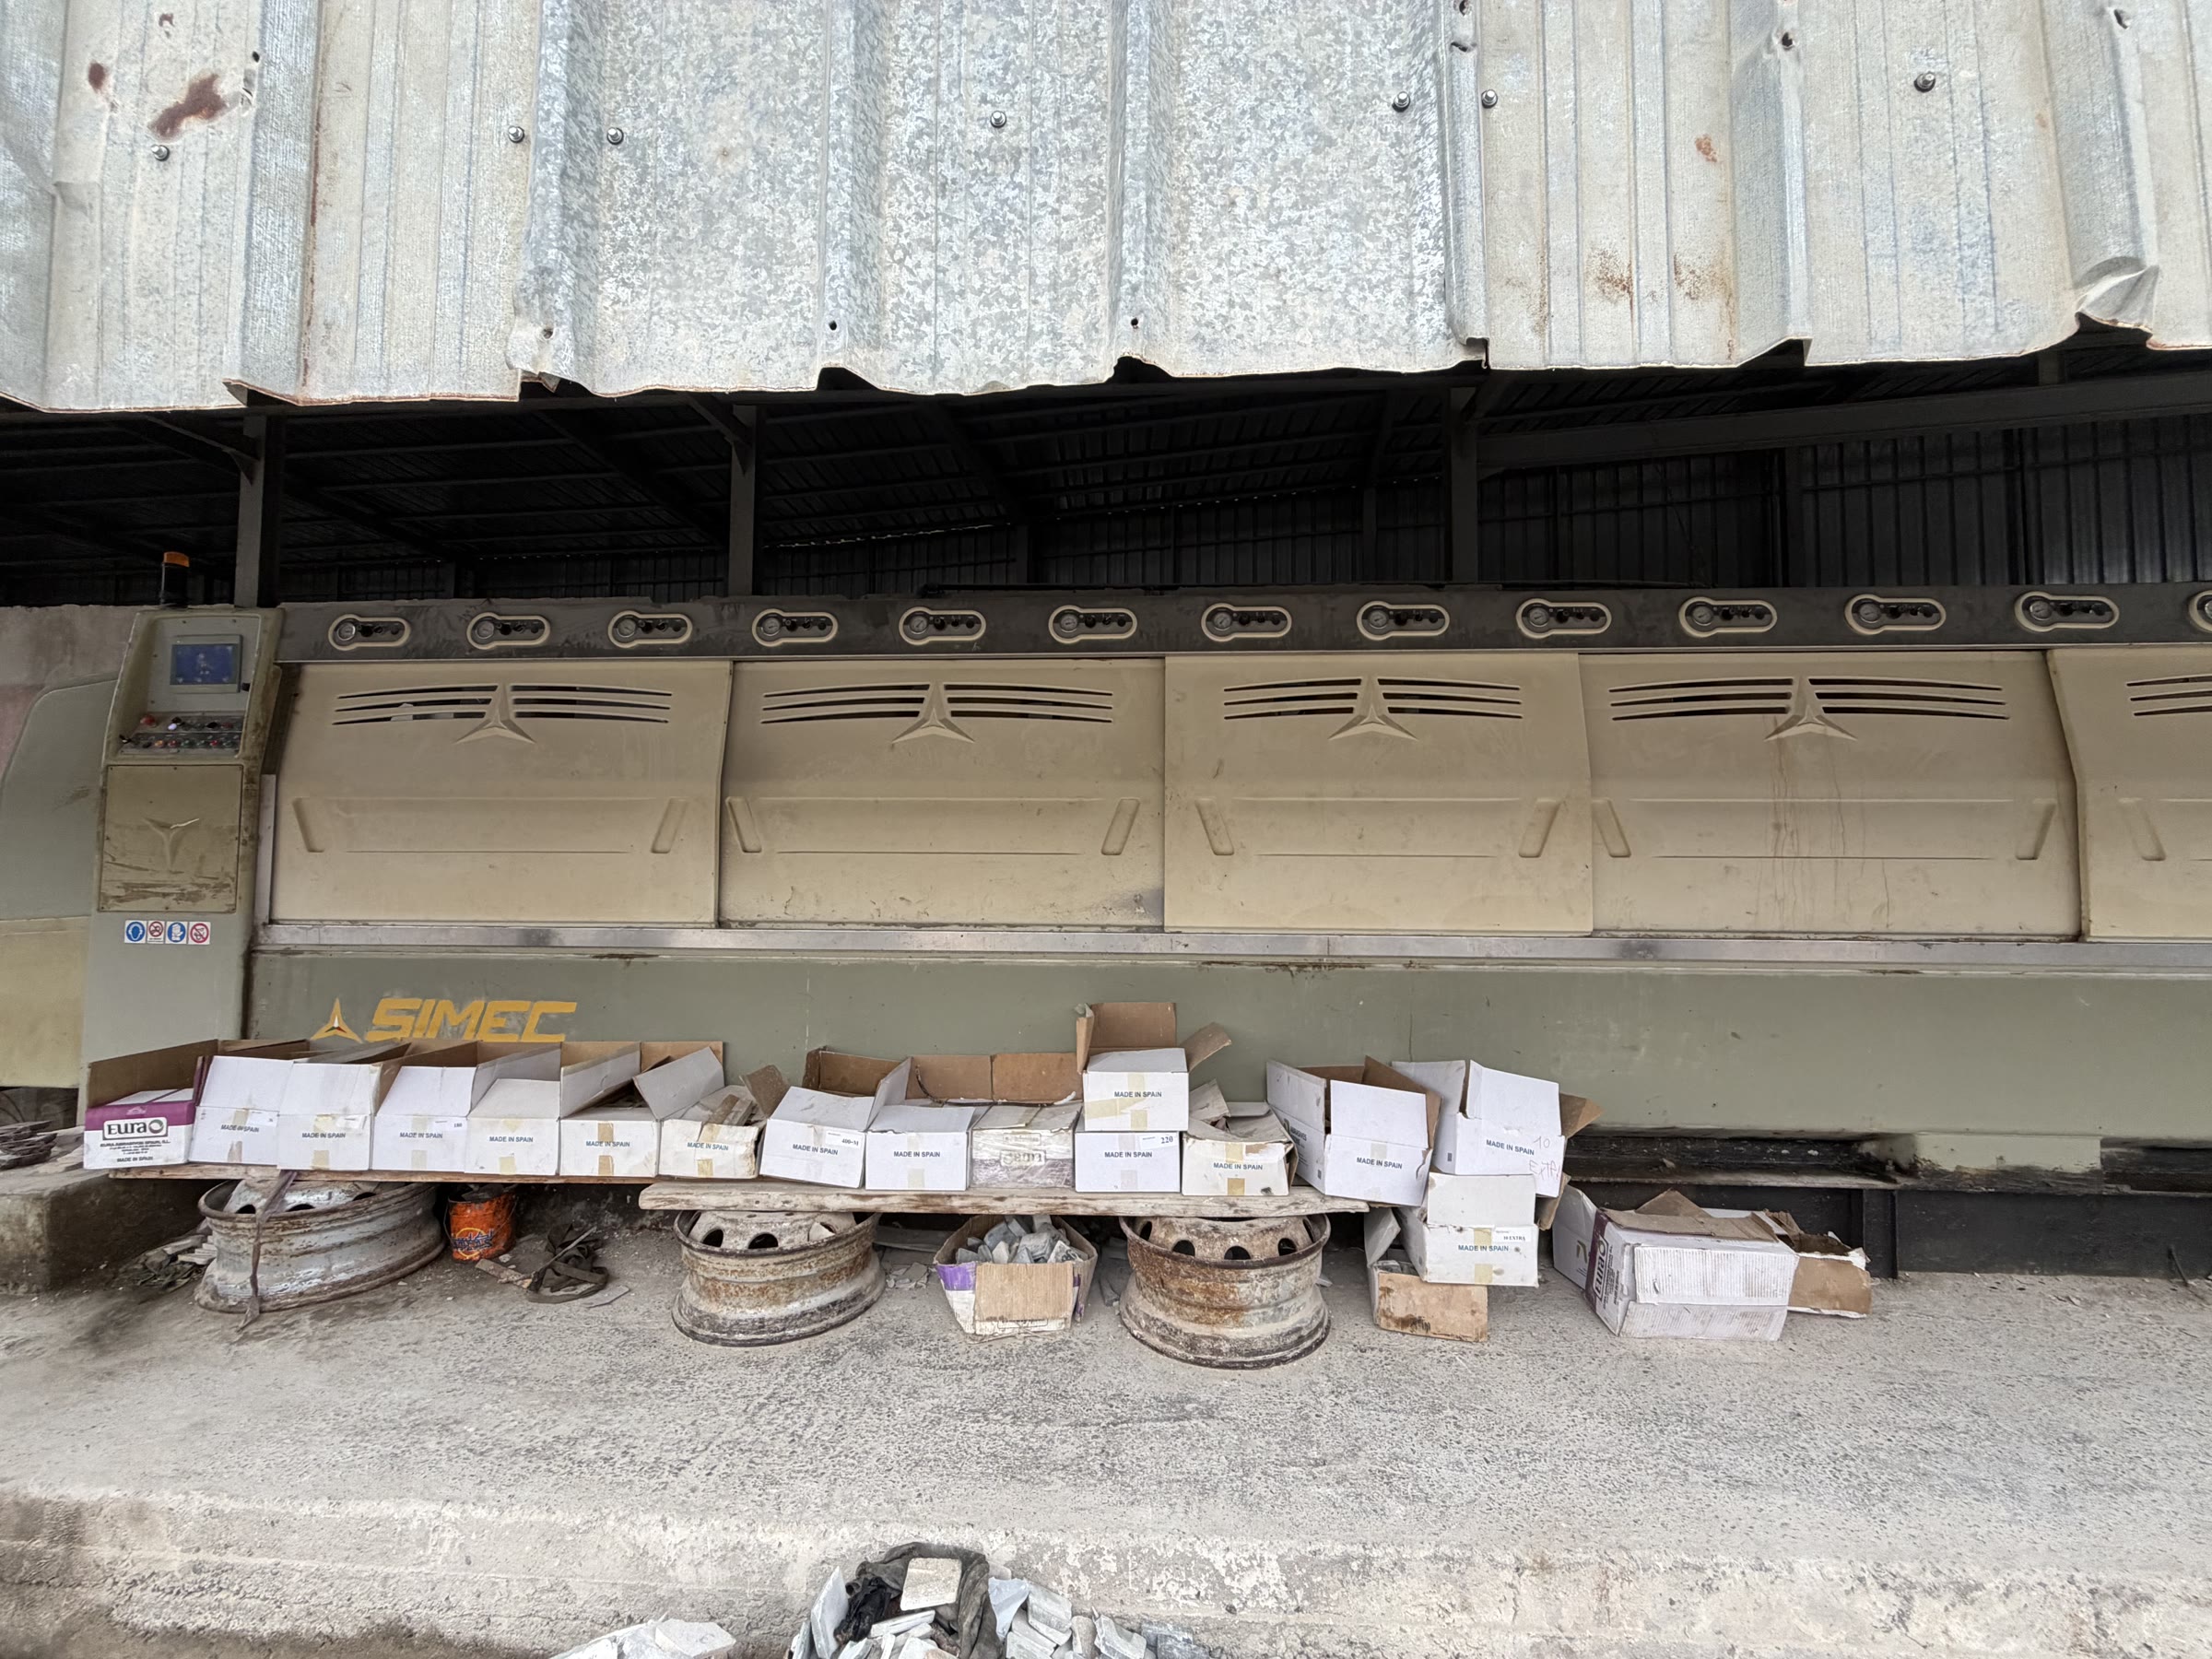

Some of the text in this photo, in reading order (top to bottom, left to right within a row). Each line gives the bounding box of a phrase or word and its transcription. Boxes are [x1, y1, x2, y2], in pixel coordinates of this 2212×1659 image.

[365, 998, 577, 1042] SIMEC
[220, 1124, 237, 1132] MADE
[1160, 1135, 1173, 1144] 220
[1533, 1135, 1550, 1149] 10
[793, 1144, 811, 1152] MADE
[819, 1147, 838, 1155] SPAIN
[1486, 1139, 1535, 1156] MADE IN SPAIN
[1356, 1157, 1374, 1166] MADE
[1383, 1160, 1403, 1170] SPAIN
